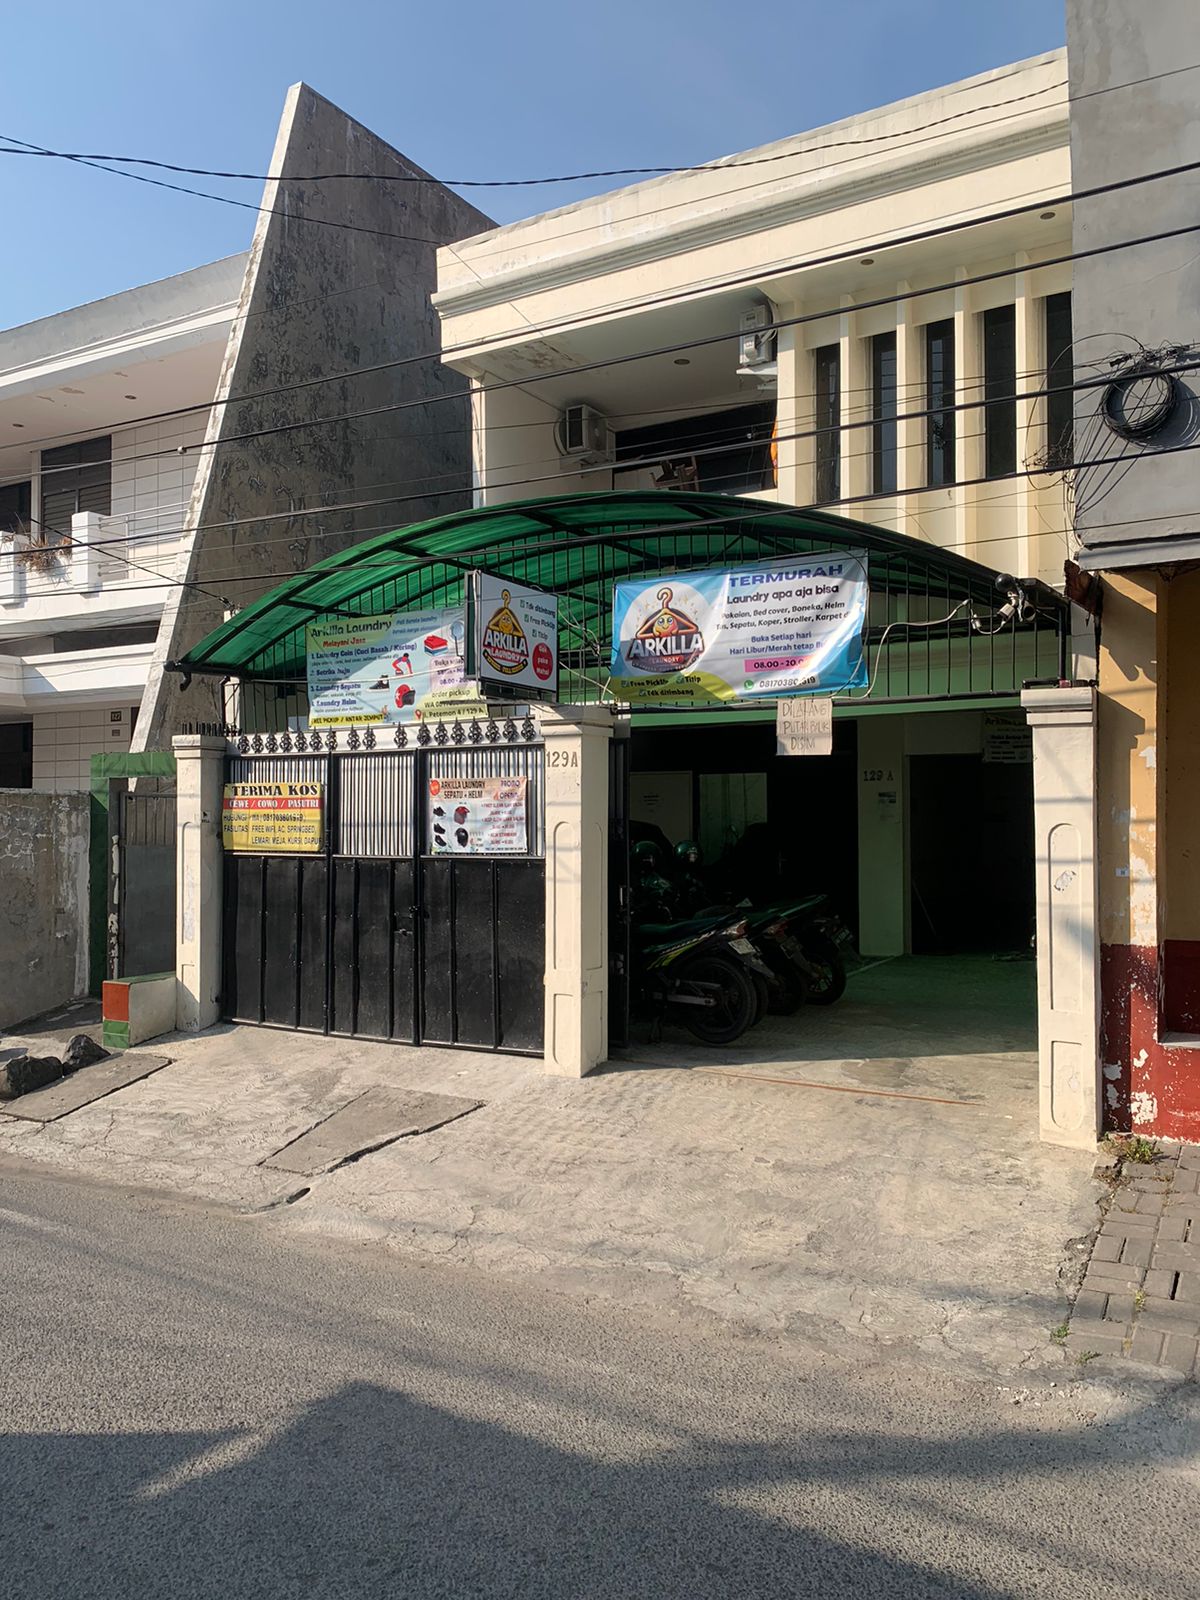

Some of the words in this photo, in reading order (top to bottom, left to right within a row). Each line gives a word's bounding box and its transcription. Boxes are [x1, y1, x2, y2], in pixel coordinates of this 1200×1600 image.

[728, 564, 844, 588] TERMURAH
[726, 591, 769, 605] Laundry
[771, 590, 793, 601] apa
[795, 587, 813, 600] aja
[815, 585, 839, 595] bisa
[753, 608, 767, 617] Bed
[768, 607, 790, 616] cover,
[792, 604, 823, 613] Boneka,
[824, 601, 845, 609] Helm
[310, 624, 344, 638] Arkilla
[346, 619, 392, 635] Laundry
[730, 620, 757, 630] Sepatu,
[758, 618, 783, 628] Koper,
[783, 615, 814, 625] Stroller,
[815, 613, 842, 622] Karpet
[485, 629, 527, 655] ARKILLA
[629, 632, 704, 658] ARKILLA
[771, 633, 795, 643] Setiap
[796, 631, 812, 640] hari
[729, 647, 745, 656] Hari
[746, 644, 793, 655] Libur/Merah
[793, 642, 814, 652] tetap
[753, 661, 779, 669] 08.00
[863, 769, 884, 781] 129
[887, 769, 894, 781] A
[231, 785, 283, 796] TERIMA
[287, 785, 318, 796] KOS
[229, 800, 249, 808] CEWE
[257, 800, 278, 808] COWO
[287, 799, 319, 808] PASUTRI
